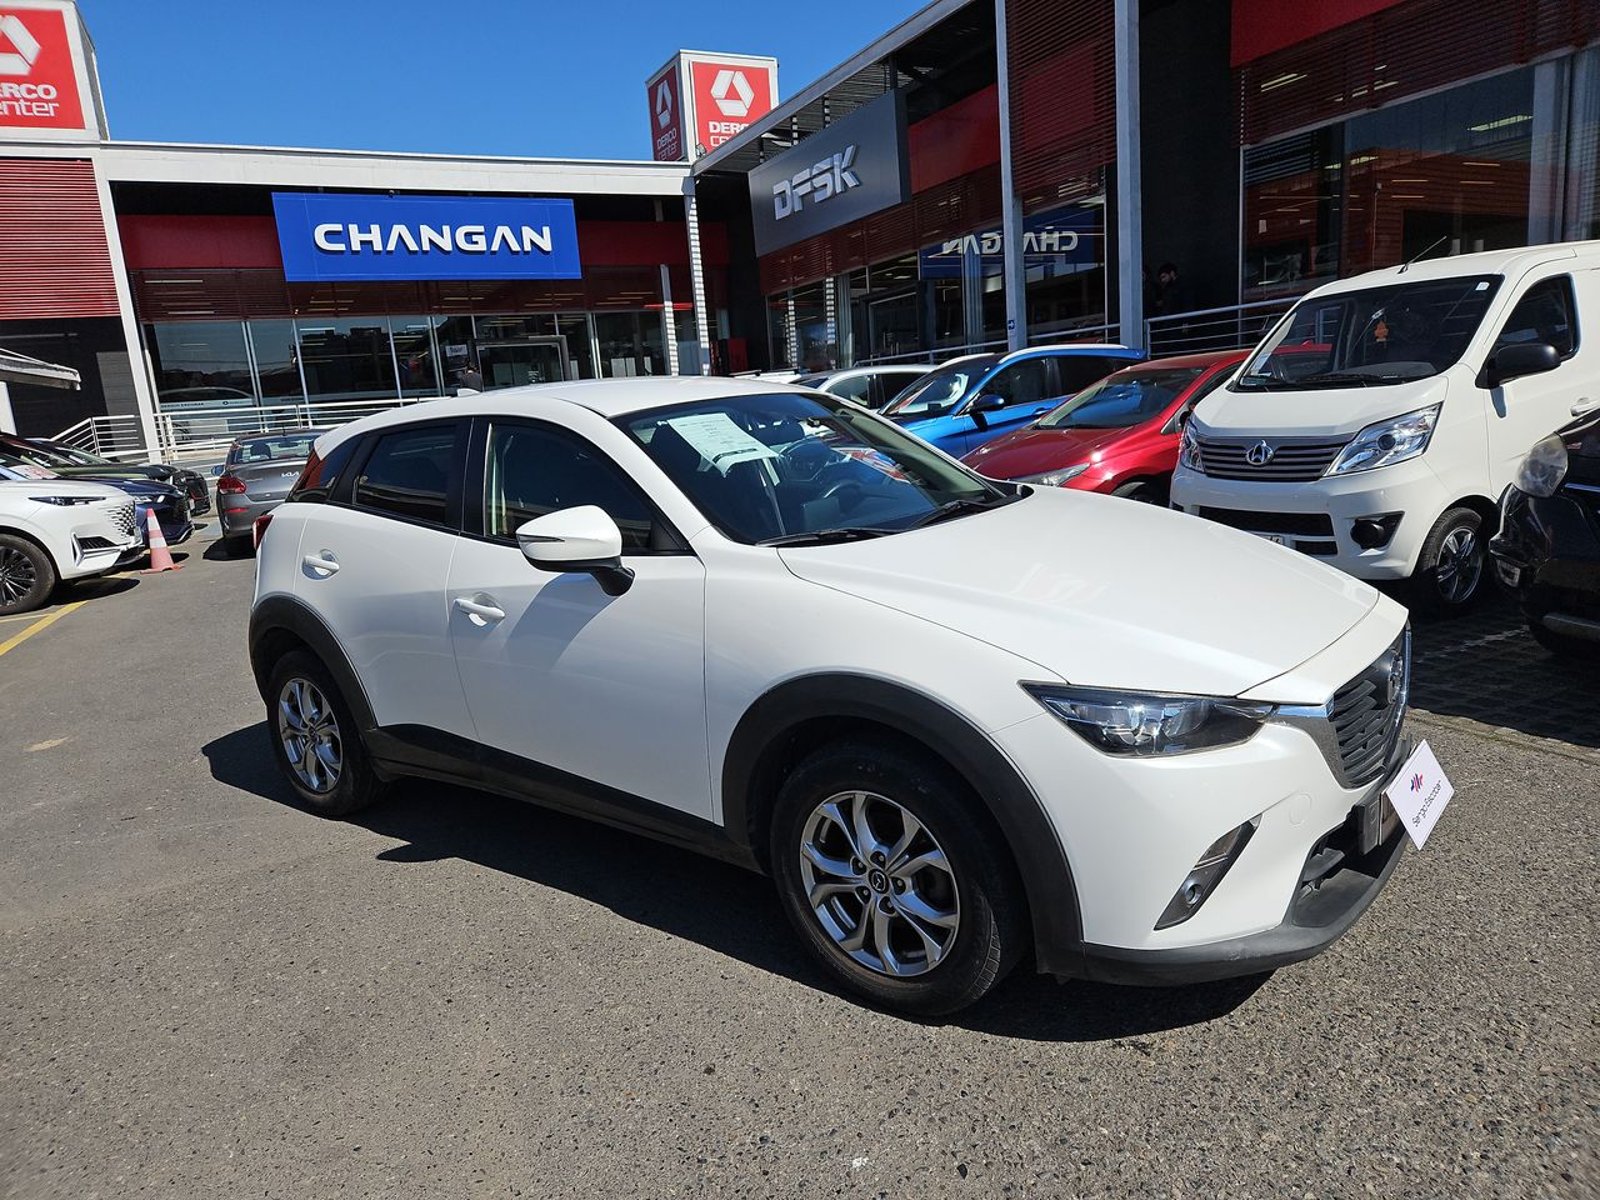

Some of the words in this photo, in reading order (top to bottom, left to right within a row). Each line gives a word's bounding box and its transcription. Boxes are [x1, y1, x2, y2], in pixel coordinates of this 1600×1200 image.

[0, 82, 58, 100] RCO
[0, 99, 60, 117] nter
[773, 145, 860, 220] DFSK
[314, 223, 552, 253] CHANGAN
